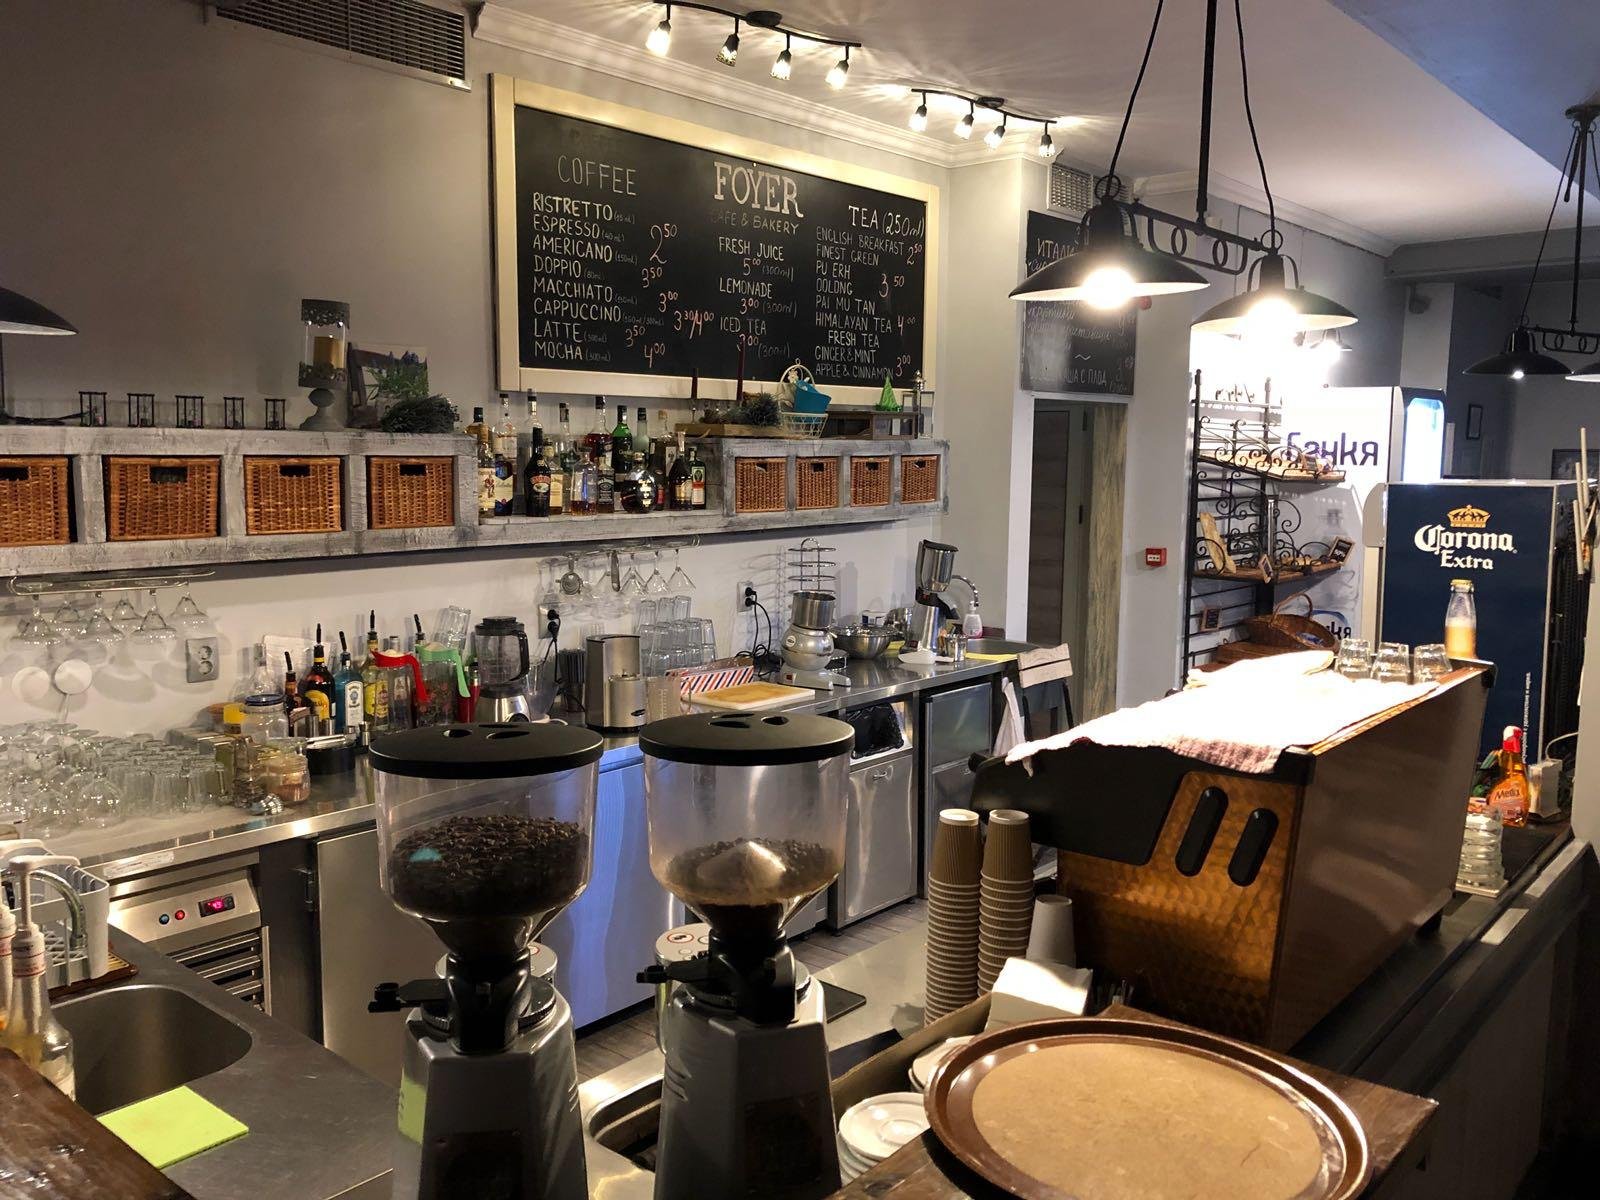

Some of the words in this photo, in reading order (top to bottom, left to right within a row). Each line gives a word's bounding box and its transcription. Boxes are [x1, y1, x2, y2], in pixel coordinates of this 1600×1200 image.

[557, 155, 637, 196] COFFEE
[714, 161, 804, 218] FOYER
[533, 191, 613, 221] RISTRETTO
[848, 205, 879, 230] TEA
[533, 213, 600, 239] ESPRESSO
[741, 212, 749, 227] &
[752, 215, 799, 235] BAKERY
[533, 234, 613, 263] AMERICANO
[719, 236, 751, 255] FRESH
[757, 242, 784, 261] JUICE
[816, 244, 846, 261] FINEST
[850, 249, 880, 266] GREEN
[858, 235, 905, 256] BREAKFAST
[533, 254, 582, 278] DOPPIO
[816, 260, 828, 275] PU
[832, 262, 851, 279] ERH
[533, 276, 613, 303] MACCHIATO
[719, 277, 773, 299] LEMONADE
[816, 278, 853, 295] OOLONG
[533, 297, 622, 323] CAPPUCCINO
[816, 295, 830, 309] PAI
[836, 297, 850, 311] MU
[855, 298, 876, 315] TAN
[533, 318, 584, 344] LATTE
[720, 317, 741, 333] ICED
[746, 318, 767, 335] TEA
[815, 312, 868, 331] HIMALAYAN
[873, 317, 892, 333] TEA
[533, 340, 583, 361] MOCHA
[828, 330, 857, 346] FRESH
[862, 333, 880, 349] TEA
[815, 363, 841, 378] APPLE
[1414, 524, 1515, 555] Corona
[1440, 549, 1494, 570] Extra
